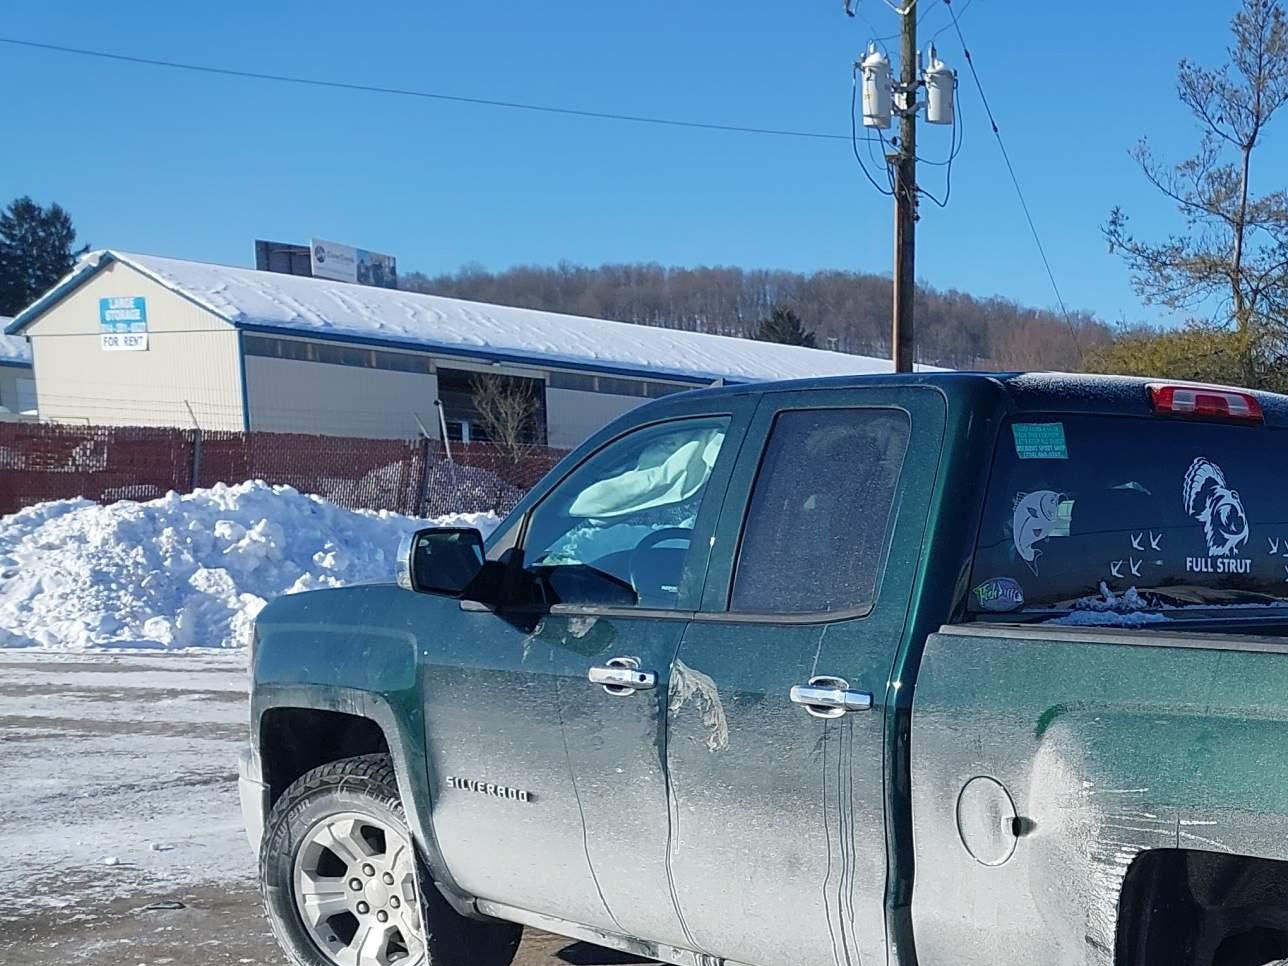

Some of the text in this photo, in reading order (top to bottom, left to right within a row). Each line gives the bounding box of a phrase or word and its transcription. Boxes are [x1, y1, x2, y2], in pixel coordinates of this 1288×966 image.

[103, 335, 144, 347] FOR RENT
[1186, 557, 1252, 574] FULL STRUT
[445, 775, 529, 803] SILVERADO
